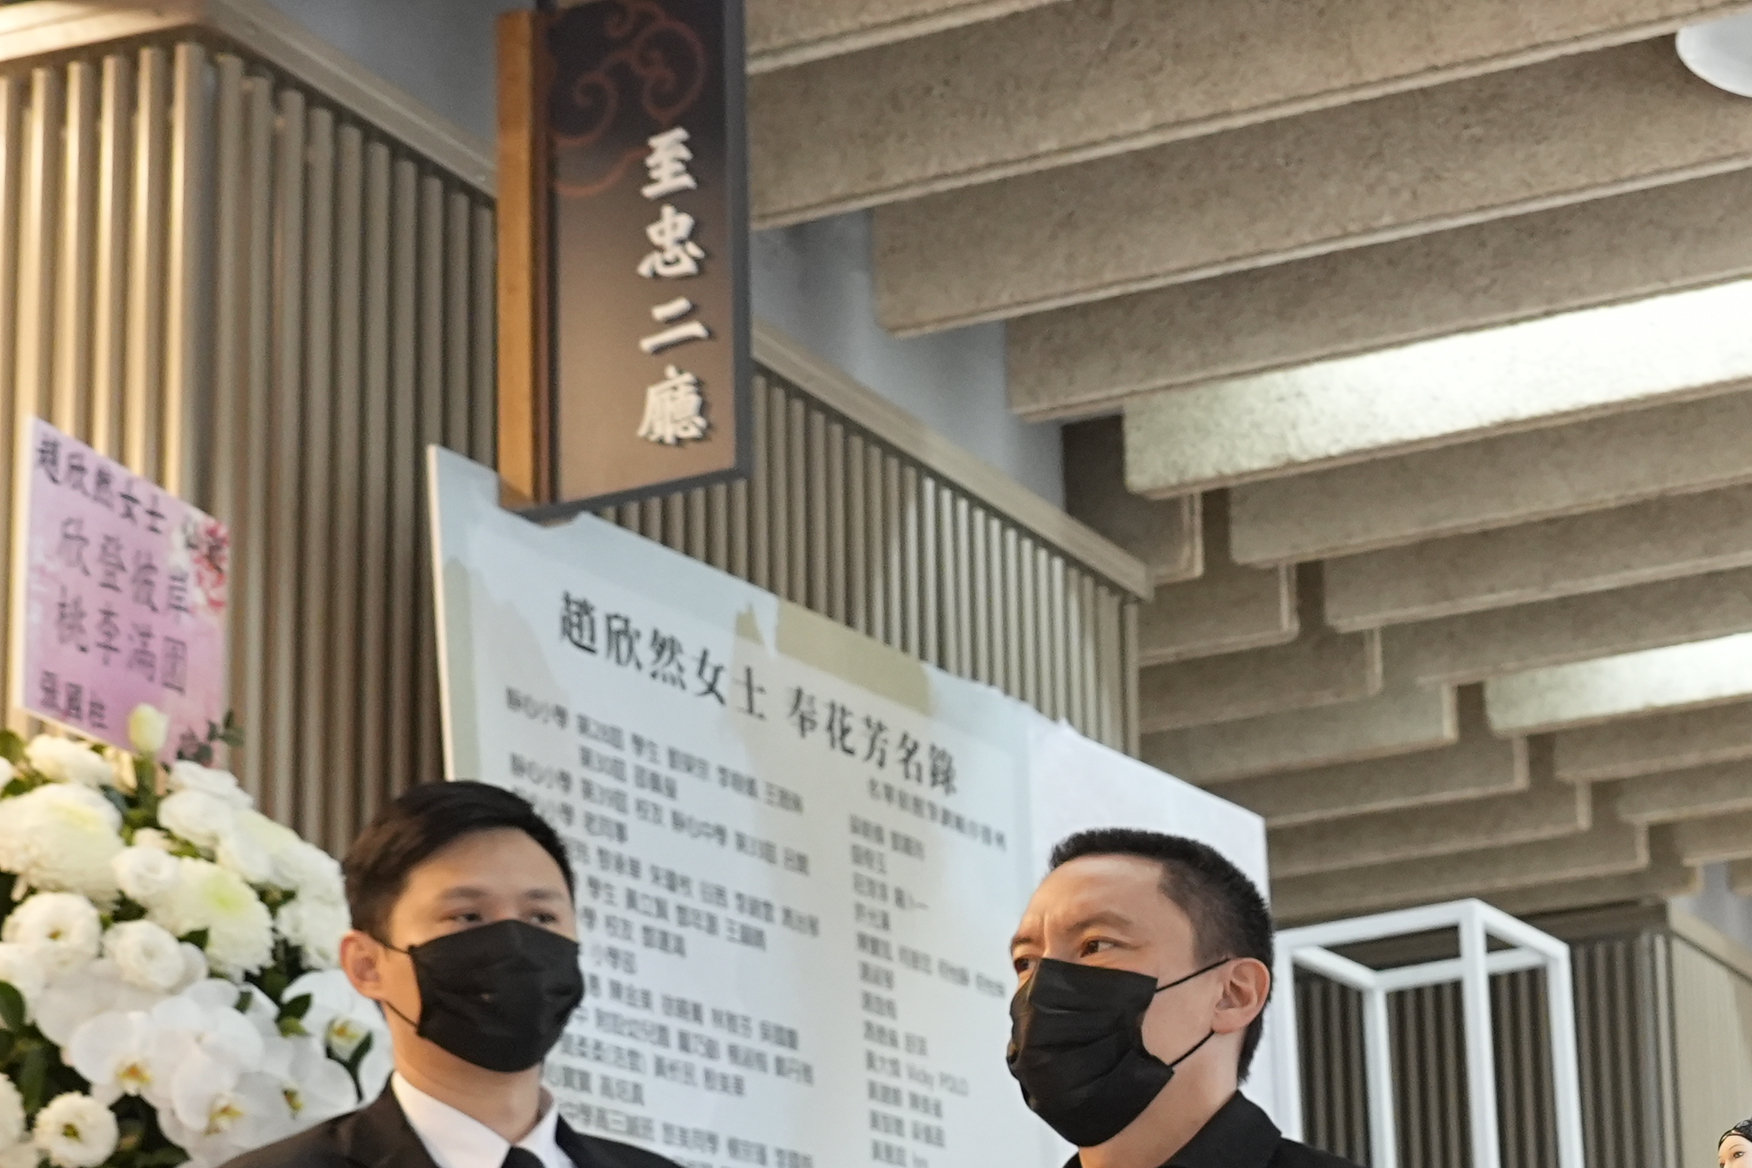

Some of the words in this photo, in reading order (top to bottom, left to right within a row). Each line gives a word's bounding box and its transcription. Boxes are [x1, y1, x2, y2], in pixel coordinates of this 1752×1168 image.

[637, 126, 709, 445] 至忠二廳
[559, 590, 767, 721] 趙欣然女士
